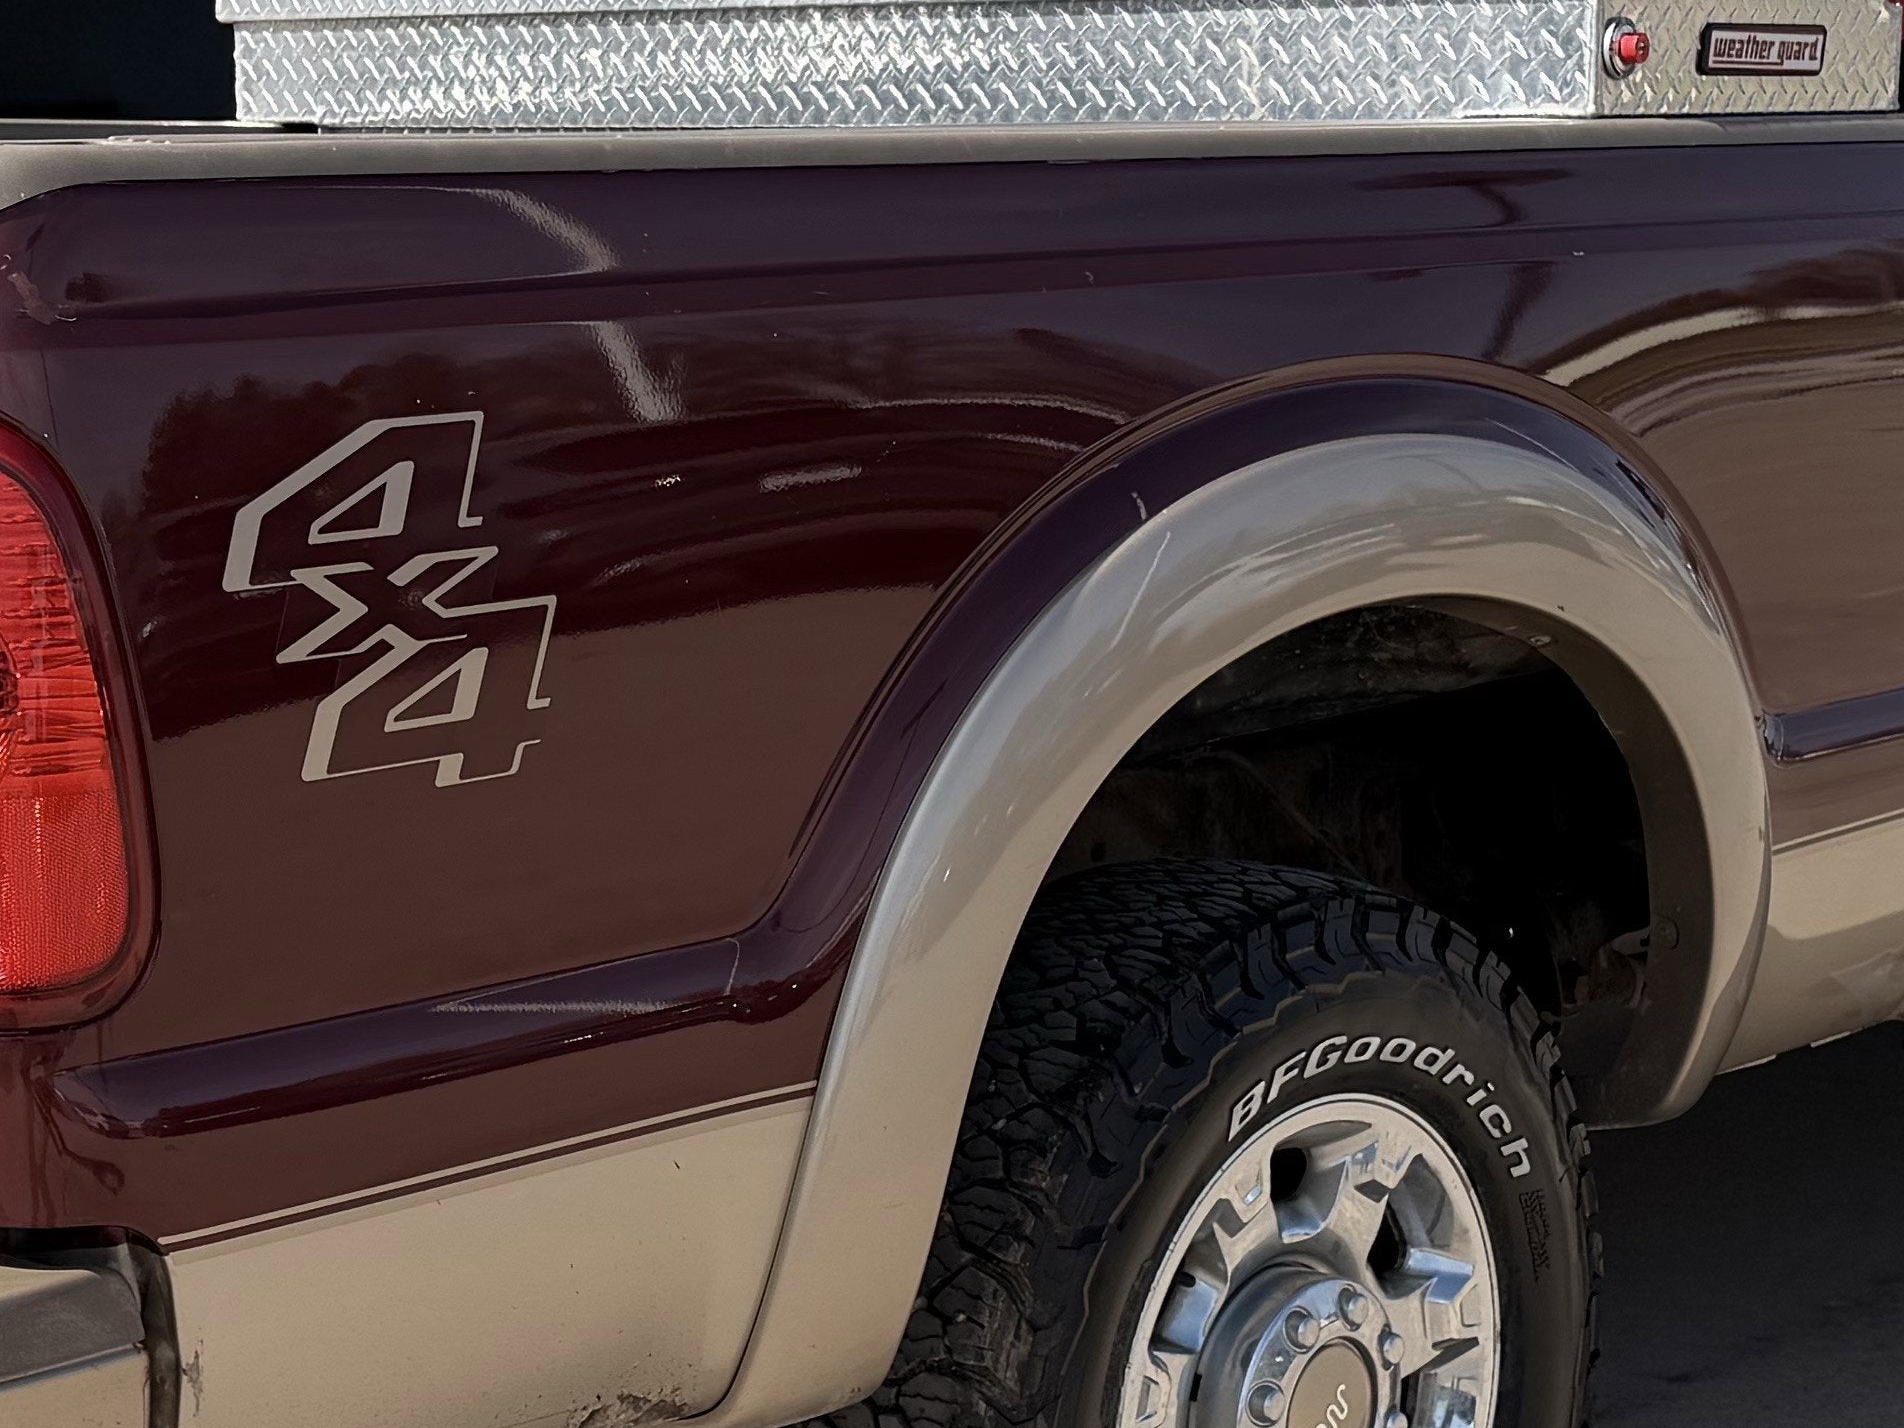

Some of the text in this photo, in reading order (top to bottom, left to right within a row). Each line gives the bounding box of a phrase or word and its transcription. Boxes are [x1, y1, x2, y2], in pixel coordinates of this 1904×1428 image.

[1712, 34, 1819, 65] weather guard
[1228, 1035, 1531, 1178] BFGoodrich
